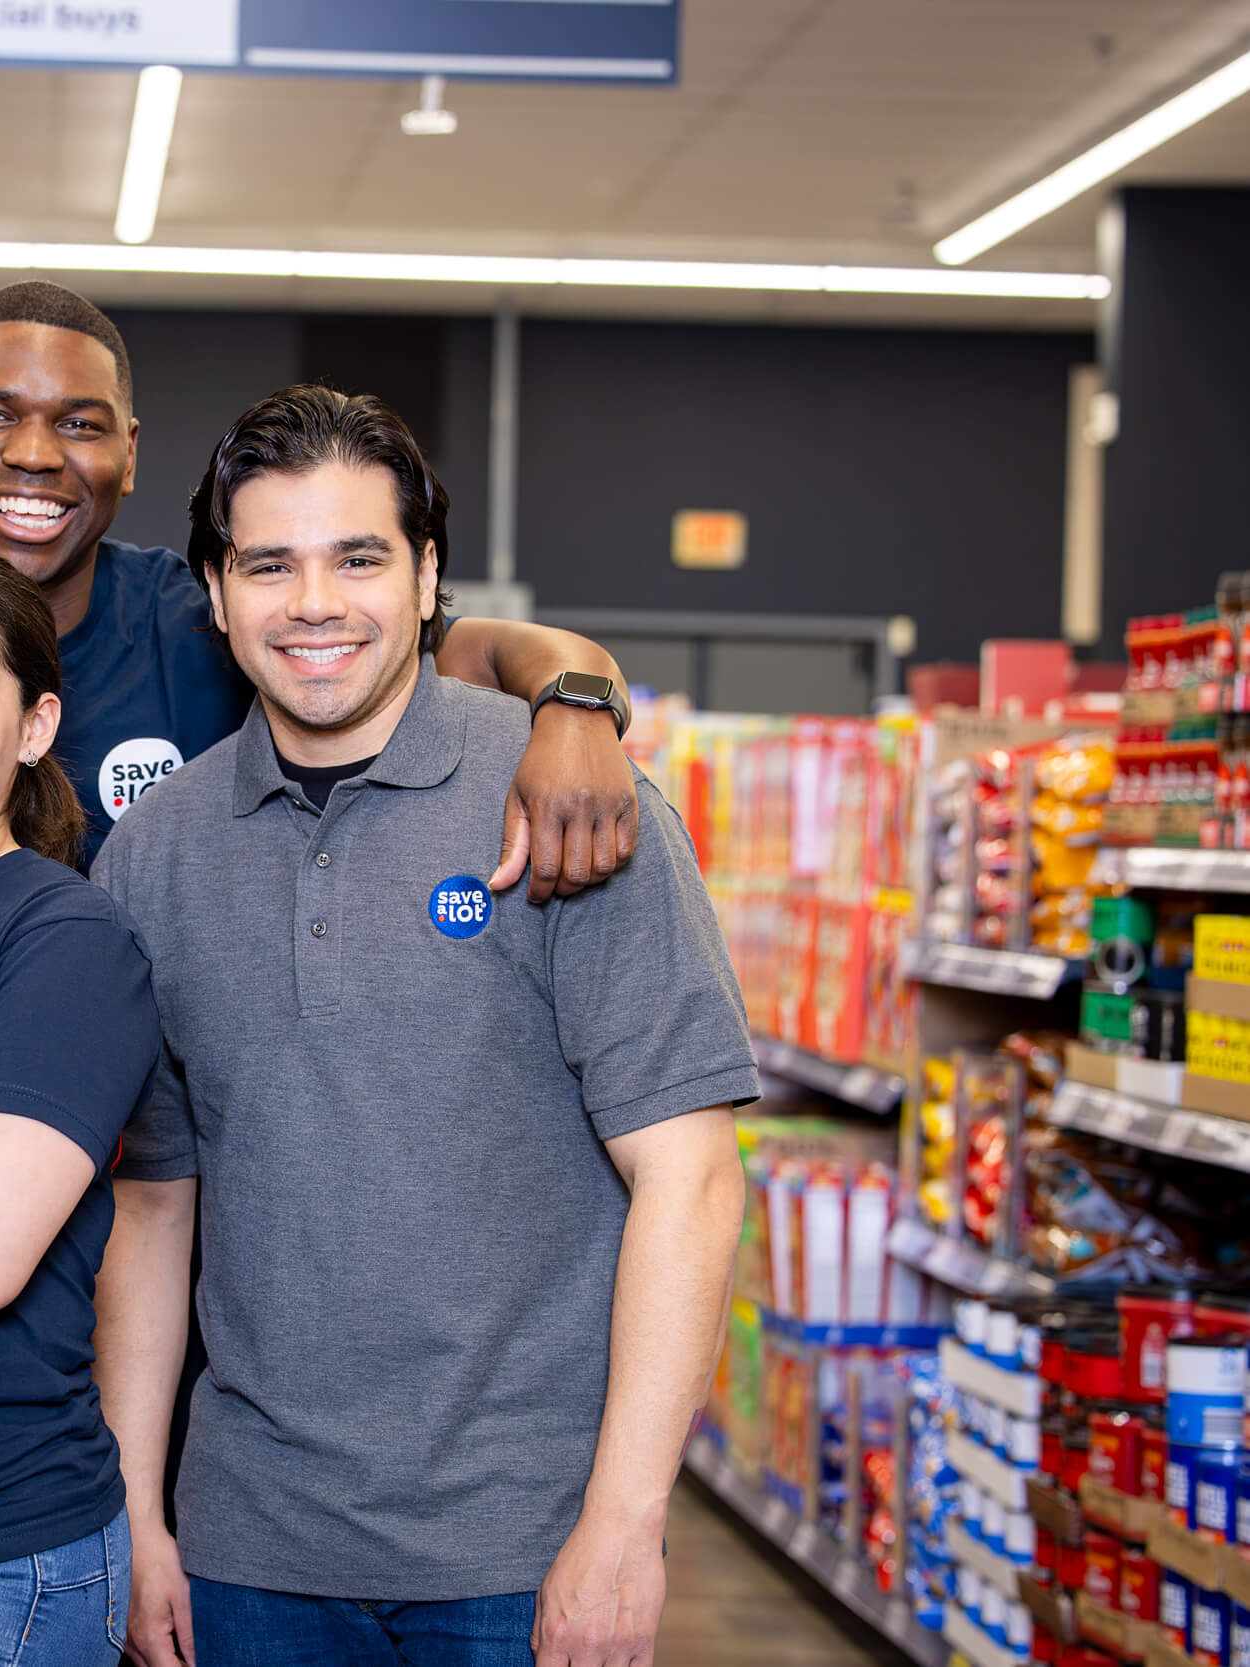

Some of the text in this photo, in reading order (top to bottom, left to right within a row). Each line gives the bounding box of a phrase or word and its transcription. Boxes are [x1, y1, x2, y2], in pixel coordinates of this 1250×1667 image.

[112, 759, 174, 781] save
[113, 784, 125, 798] a
[437, 890, 484, 905] save
[437, 904, 484, 922] a lot
